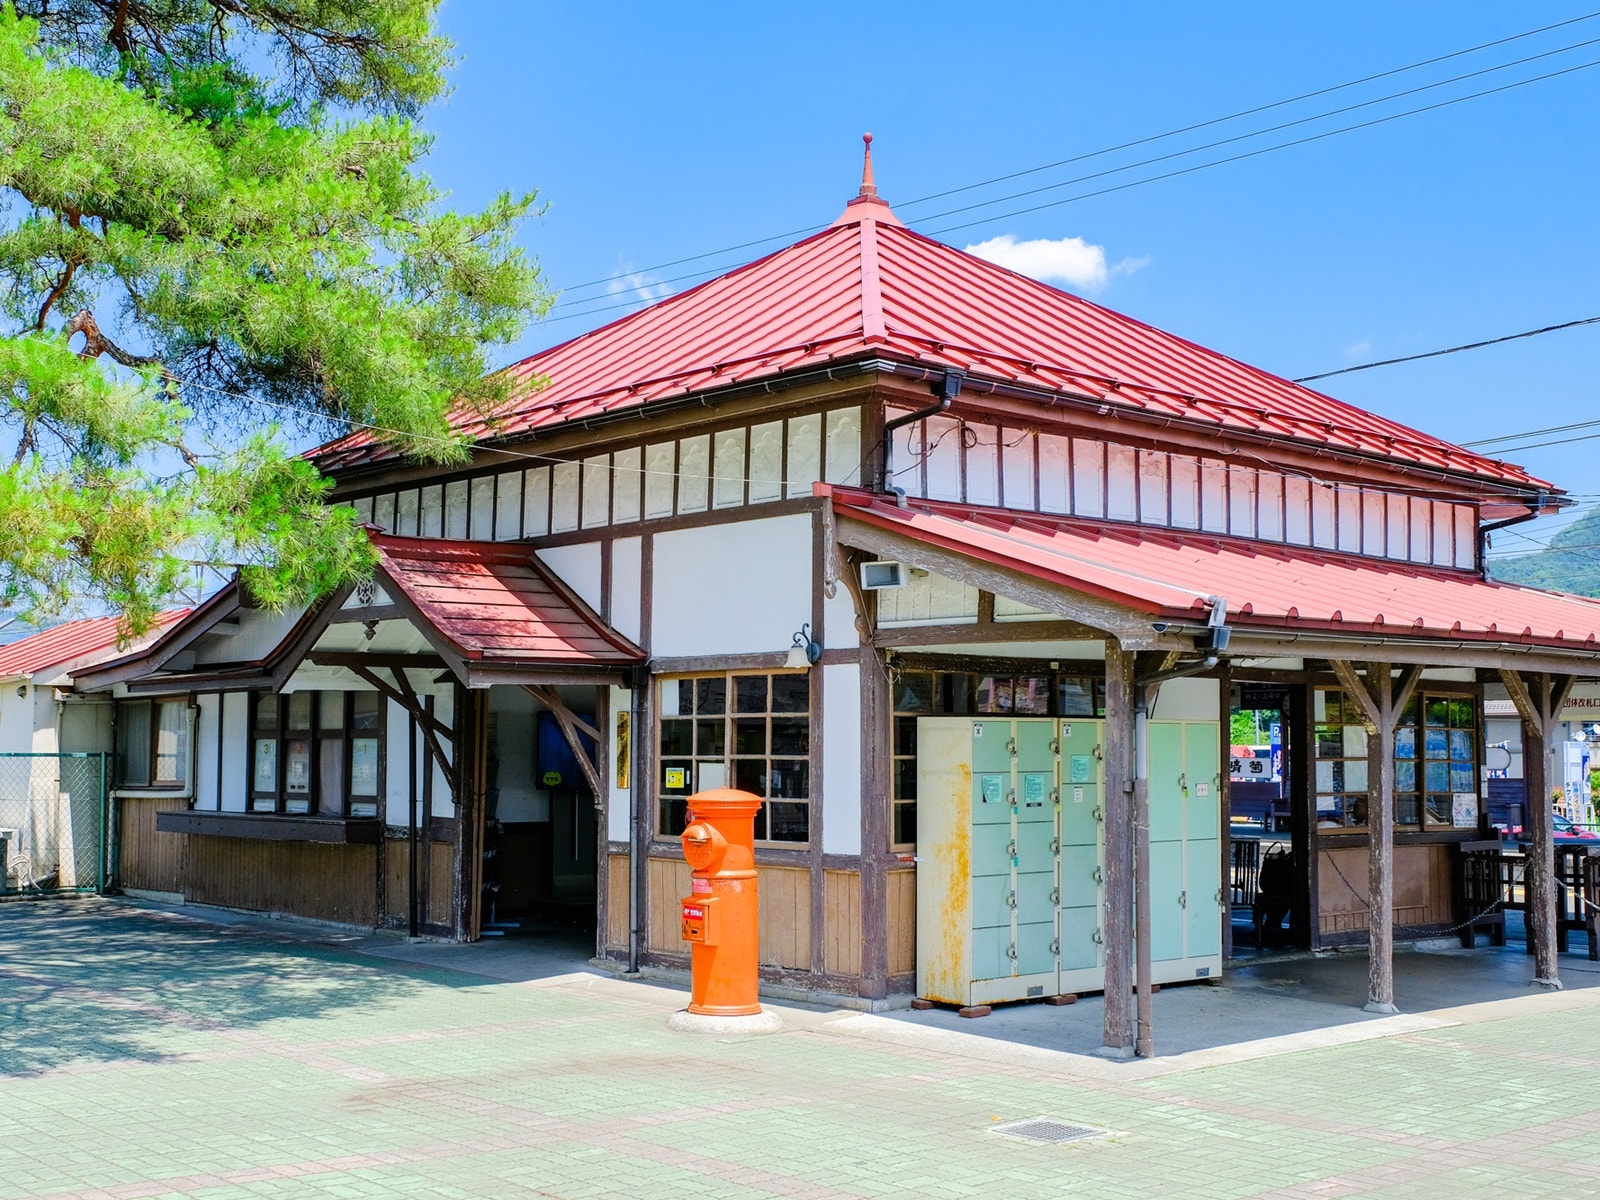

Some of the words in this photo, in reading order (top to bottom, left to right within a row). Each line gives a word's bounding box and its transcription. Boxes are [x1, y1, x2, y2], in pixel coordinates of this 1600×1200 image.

[1562, 698, 1600, 708] 団体改札口
